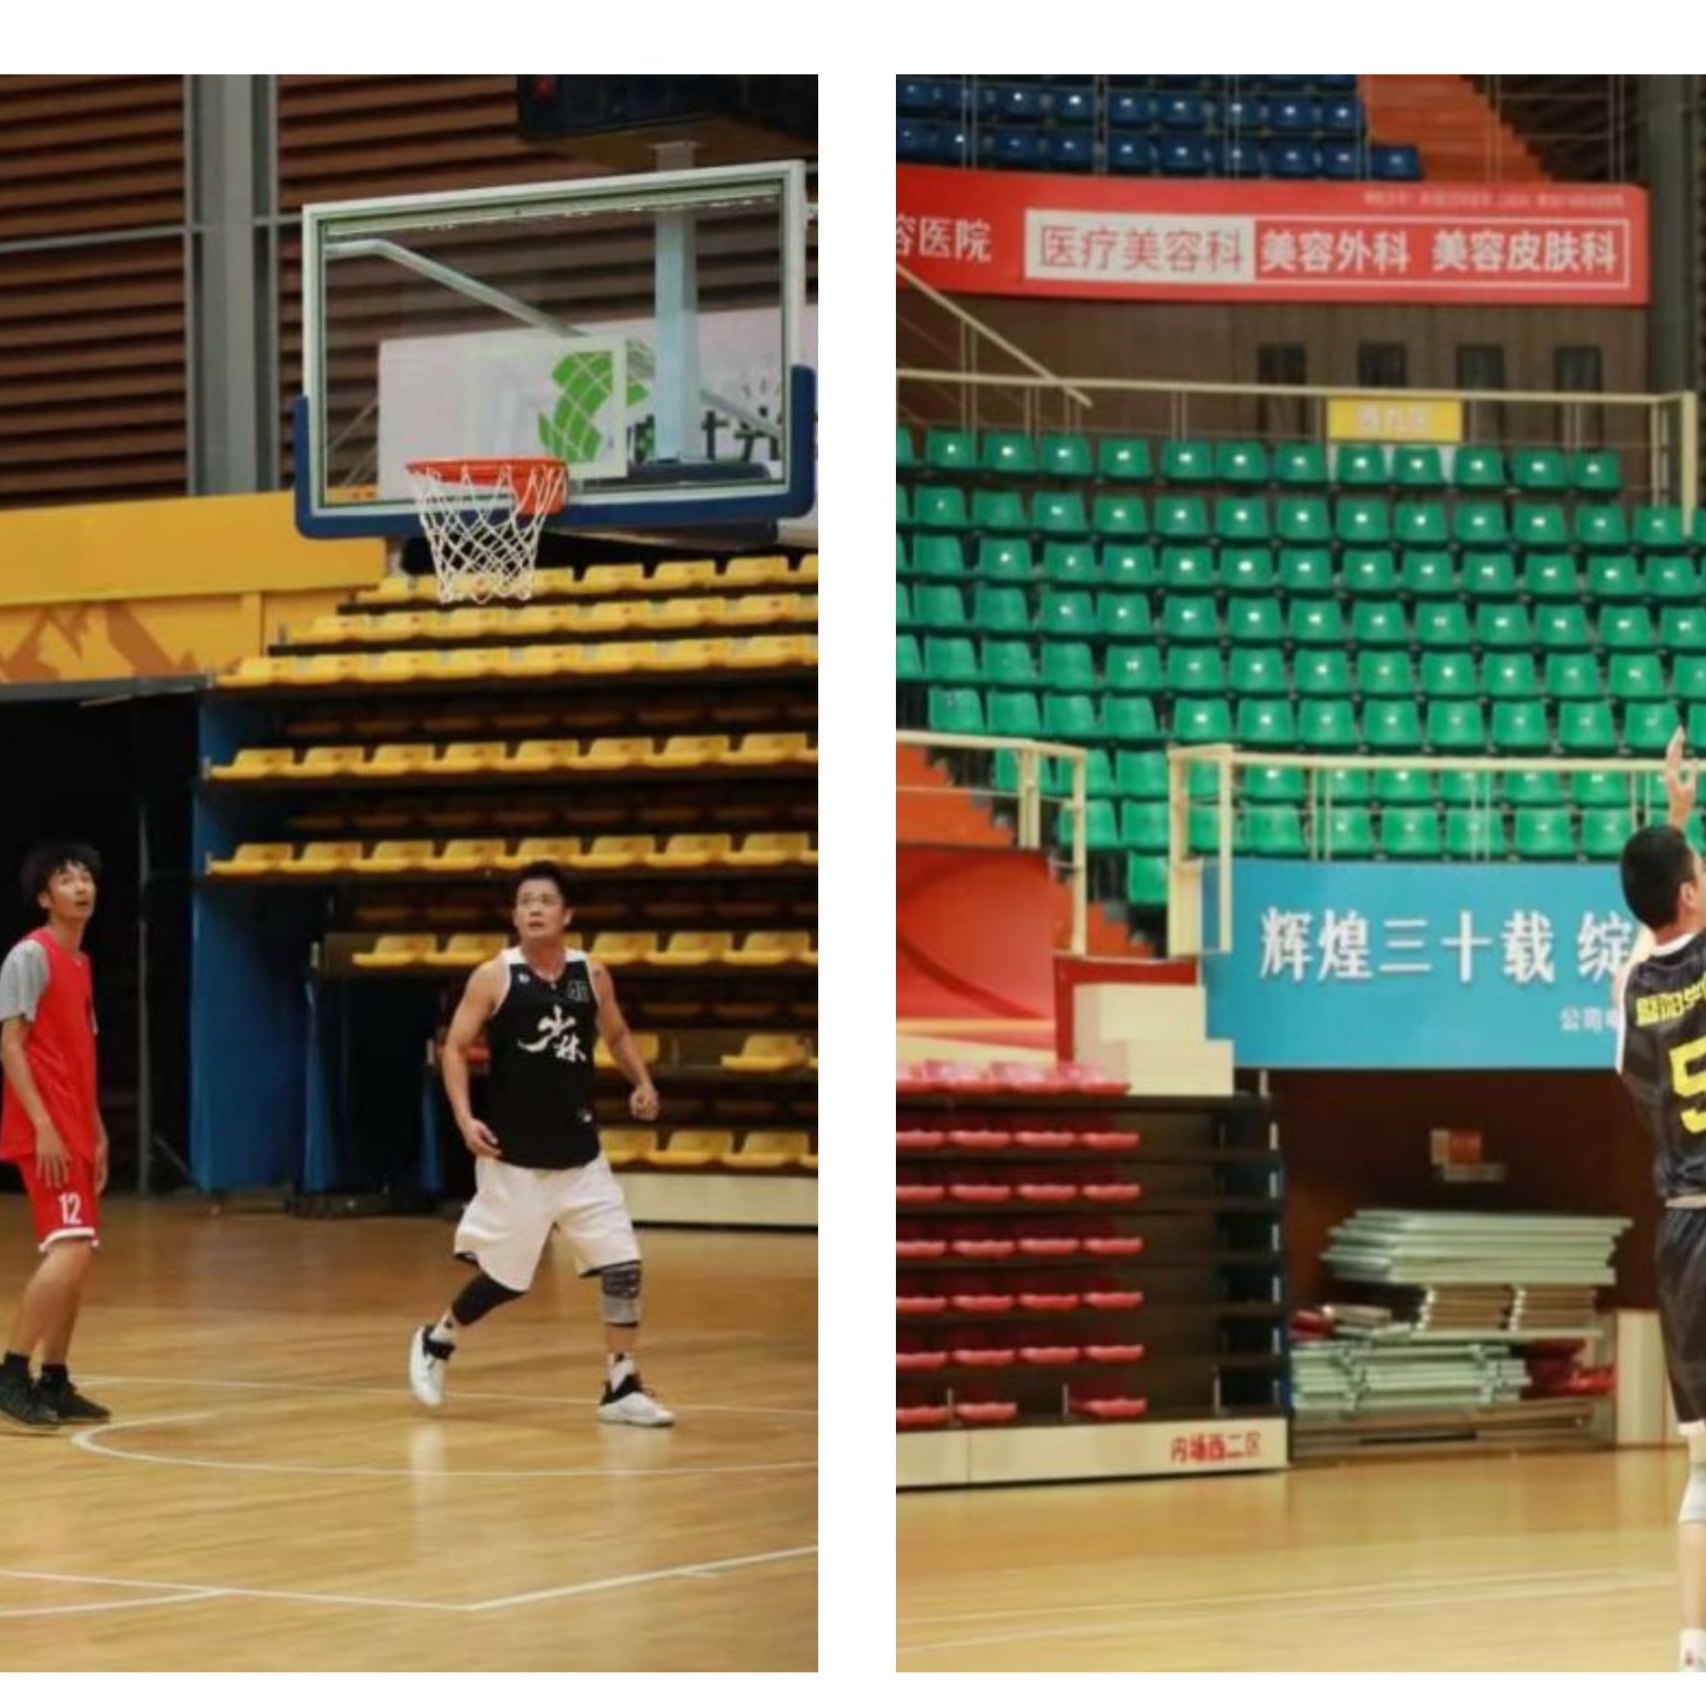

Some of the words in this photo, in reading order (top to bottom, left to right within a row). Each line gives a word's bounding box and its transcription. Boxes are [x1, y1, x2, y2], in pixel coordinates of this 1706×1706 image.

[1040, 223, 1242, 274] 医疗美容科
[1260, 228, 1411, 275] 美容外科
[1431, 229, 1617, 276] 美容皮肤科
[1260, 906, 1556, 984] 辉煌三十载
[517, 1004, 587, 1063] 少林
[58, 1191, 82, 1225] 12
